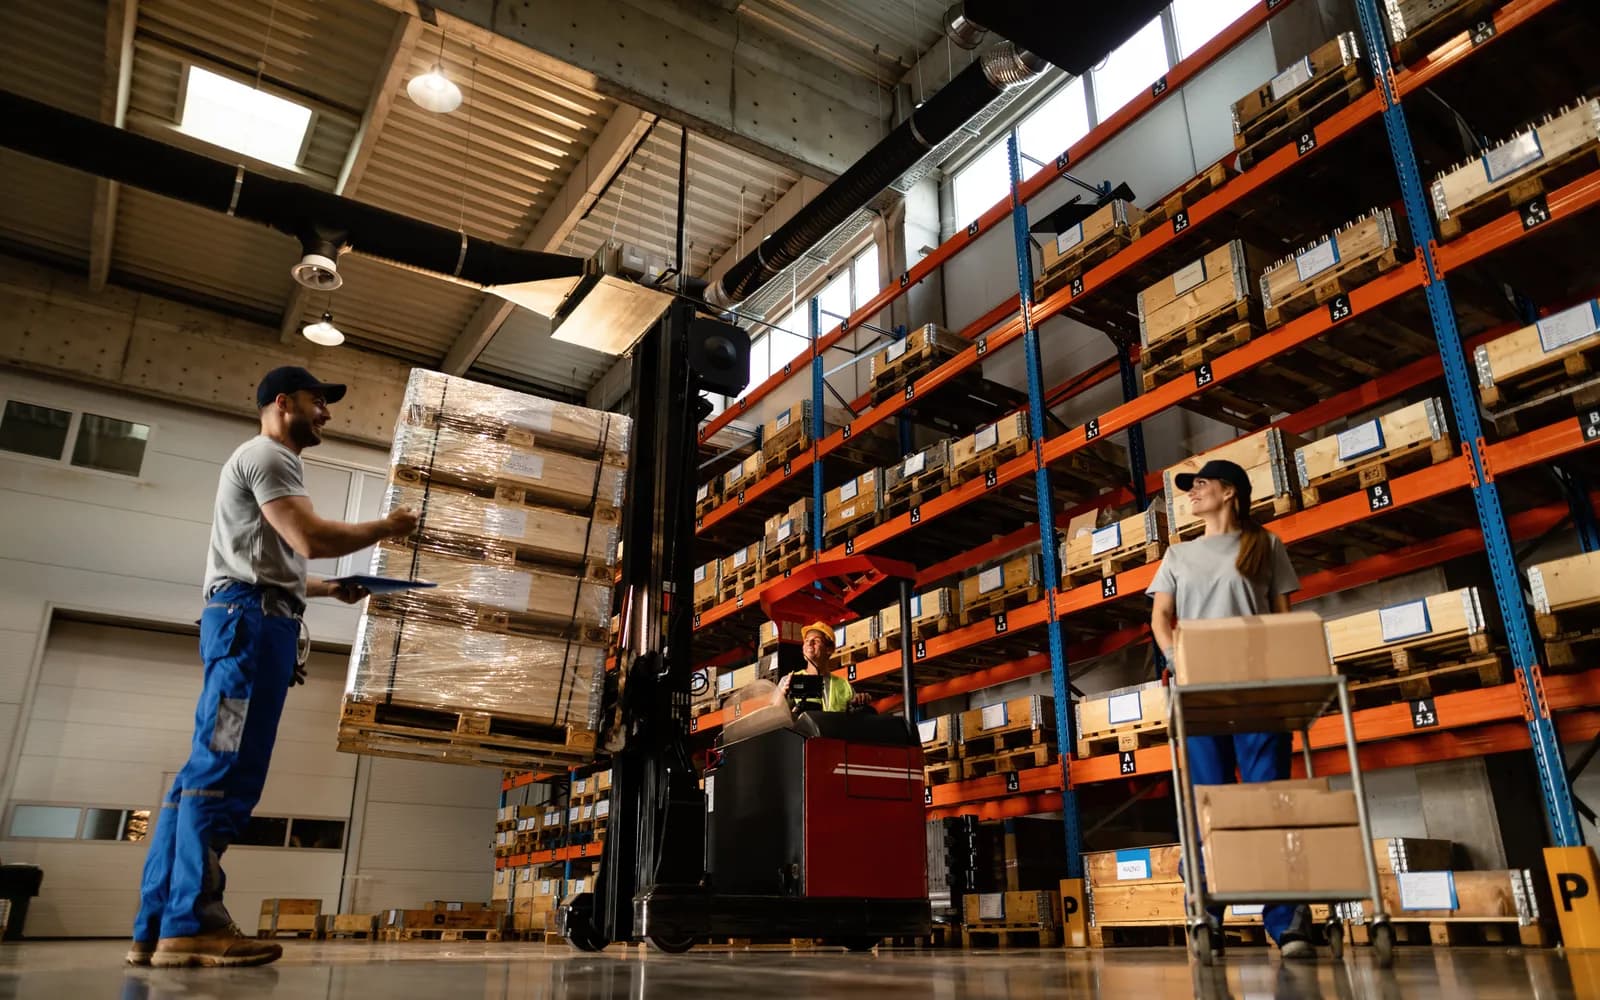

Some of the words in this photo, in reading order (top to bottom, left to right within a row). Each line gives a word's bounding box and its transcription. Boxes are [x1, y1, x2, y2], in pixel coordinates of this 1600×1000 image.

[1475, 27, 1492, 43] 6.1
[1259, 86, 1273, 108] H
[1301, 134, 1309, 143] D
[1299, 139, 1314, 154] 5.3
[1529, 202, 1539, 213] C
[1177, 214, 1183, 223] D
[1526, 209, 1546, 226] 6.1
[1175, 219, 1188, 232] 5.2
[1074, 279, 1080, 288] D
[1072, 284, 1082, 296] 5.1
[1335, 297, 1343, 307] C
[1333, 306, 1349, 320] 5.3
[1200, 366, 1206, 375] C
[1198, 373, 1211, 386] 5.2
[1590, 411, 1600, 424] B
[1089, 420, 1095, 428] C
[1087, 428, 1098, 439] 5.1
[1374, 486, 1382, 497] B
[1372, 496, 1389, 509] 5.3
[1106, 578, 1112, 587] B
[1104, 586, 1115, 597] 5.1
[1418, 701, 1428, 713] A
[1415, 712, 1435, 727] 5.3
[1124, 752, 1131, 762] A
[1122, 762, 1134, 774] 5.1
[1010, 773, 1016, 782] A
[1007, 782, 1019, 790] 4.3
[1556, 873, 1590, 912] P
[1063, 895, 1079, 924] P
